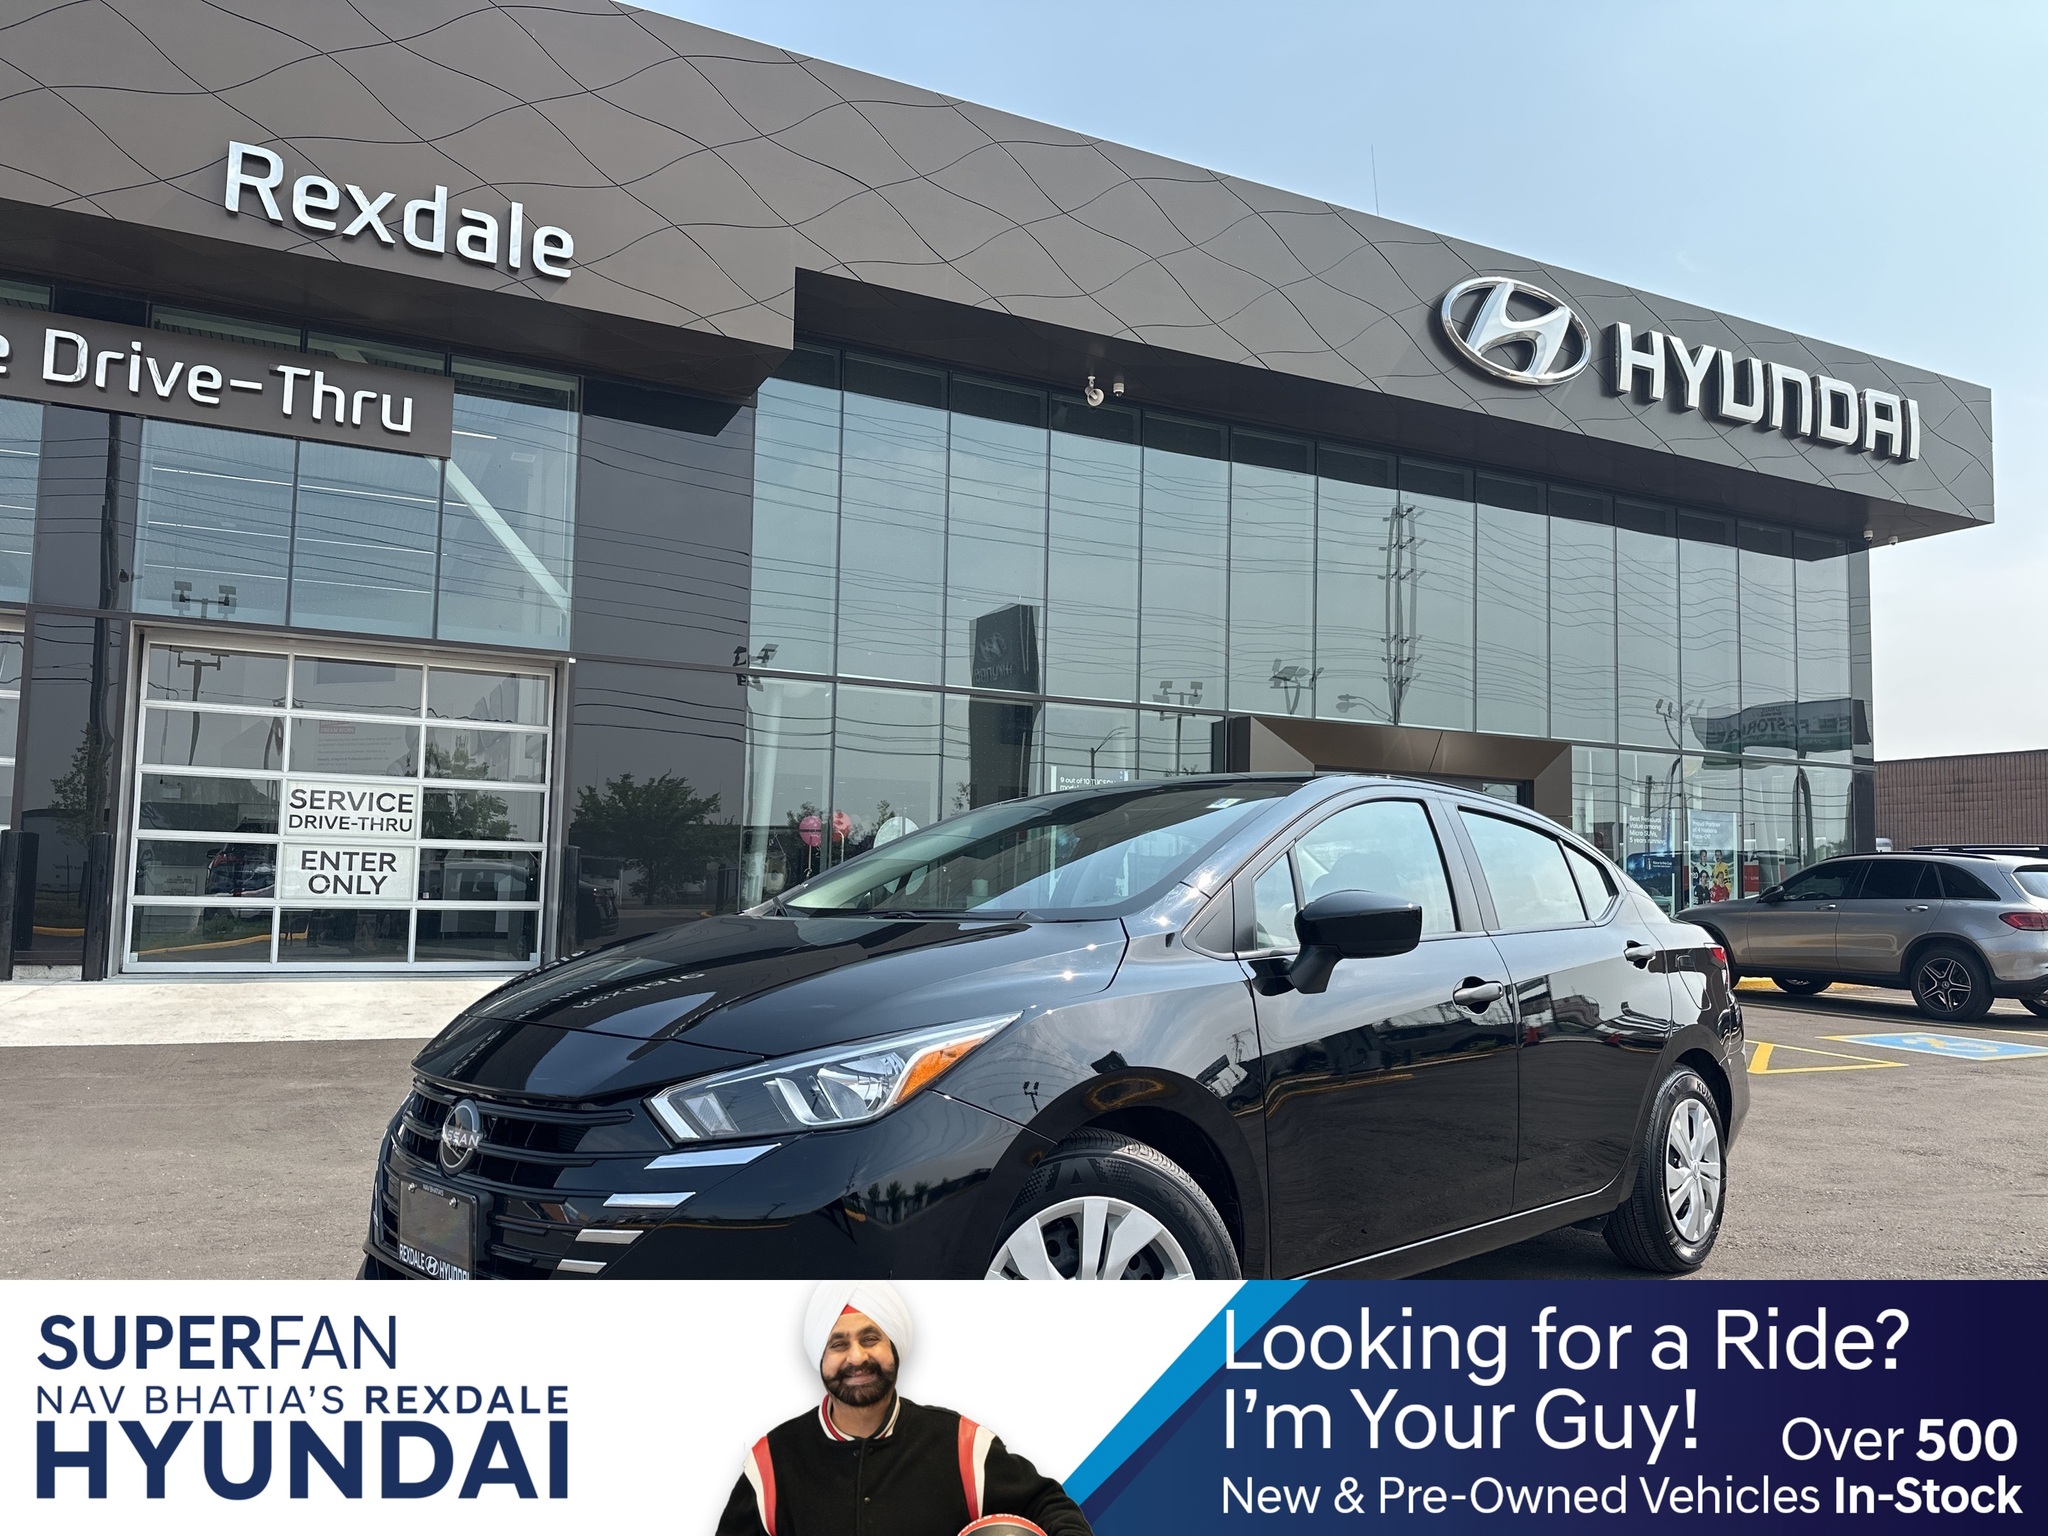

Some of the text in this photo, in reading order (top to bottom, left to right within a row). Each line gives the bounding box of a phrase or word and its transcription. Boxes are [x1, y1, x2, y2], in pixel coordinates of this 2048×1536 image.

[225, 140, 574, 279] Rexdale
[42, 328, 413, 434] Drive-Thru
[1616, 321, 1920, 462] HYUNDAI
[289, 788, 414, 813] SERVICE
[288, 814, 413, 832] DRIVE-THRU
[301, 850, 397, 872] ENTER
[308, 874, 388, 895] ONLY
[446, 1129, 480, 1147] SSAN
[400, 1243, 425, 1271] REXDALE
